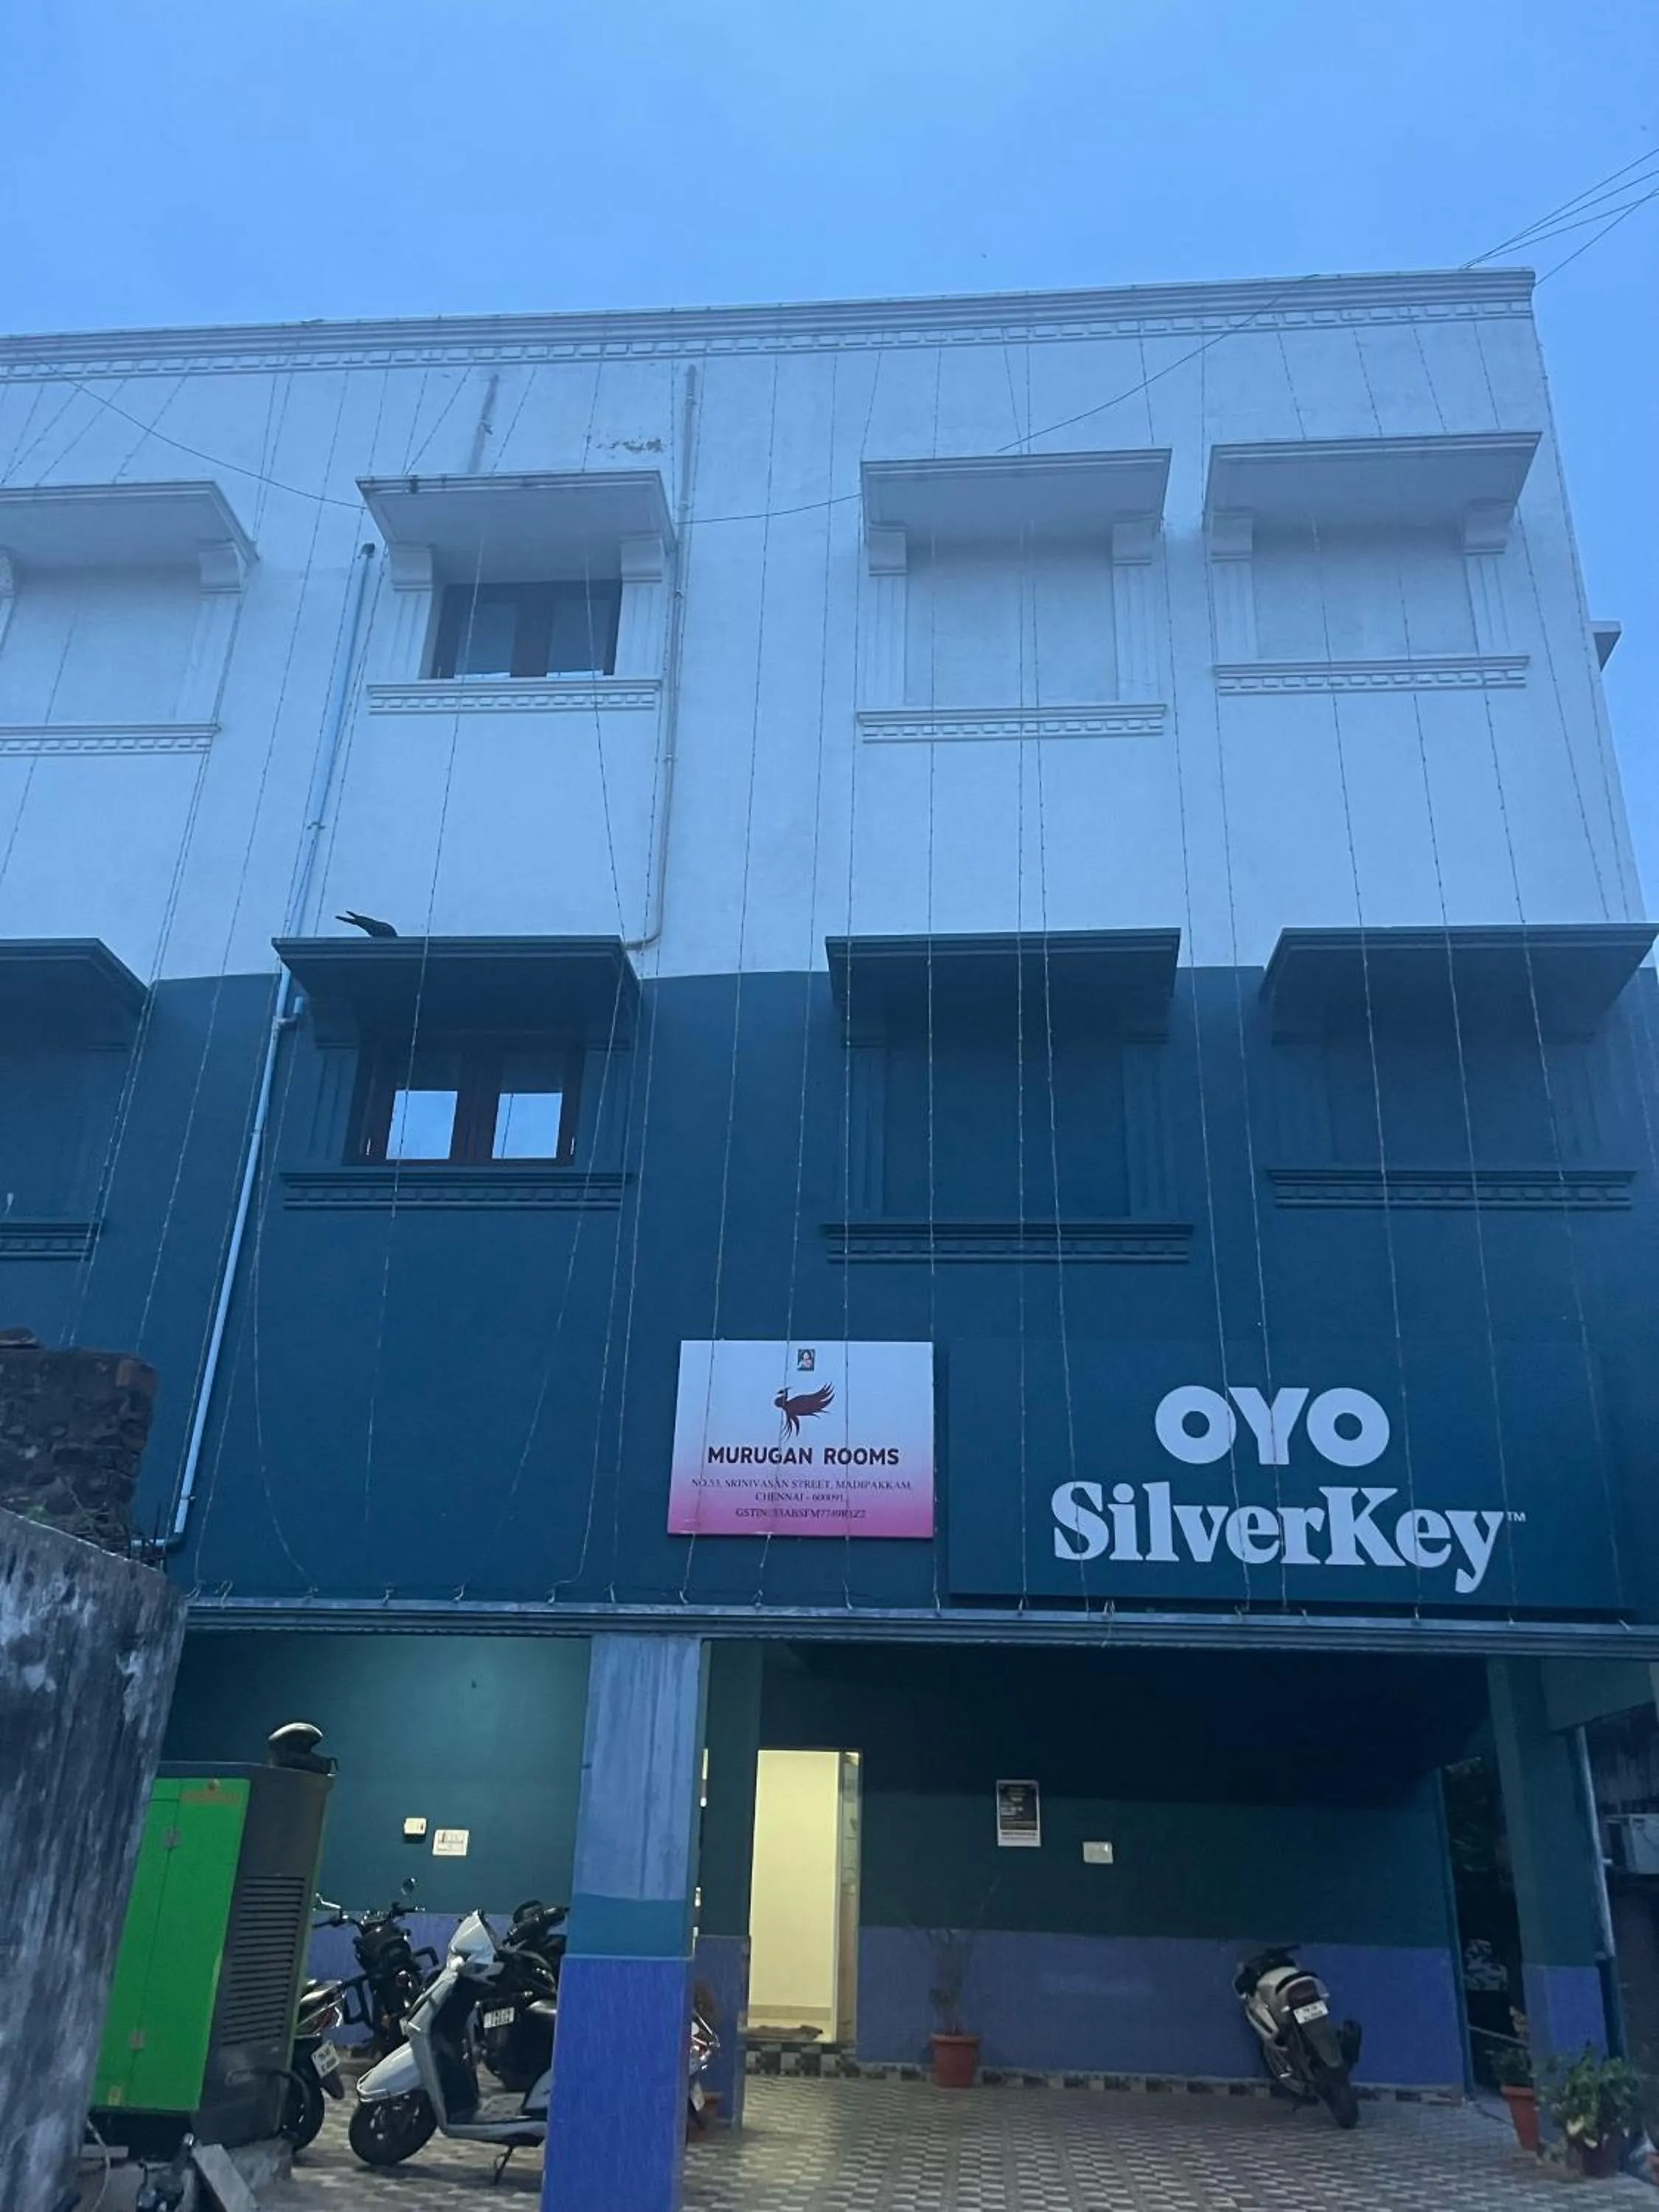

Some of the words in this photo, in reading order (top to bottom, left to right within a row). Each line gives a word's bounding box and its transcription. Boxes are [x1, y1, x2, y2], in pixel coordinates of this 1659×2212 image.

[1155, 1385, 1391, 1467] OYO
[708, 1447, 812, 1464] MURUGAN
[824, 1447, 900, 1465] ROOMS
[725, 1478, 789, 1488] SRINIVASAN
[755, 1492, 804, 1501] CHENNAI
[1051, 1481, 1505, 1593] SilverKey
